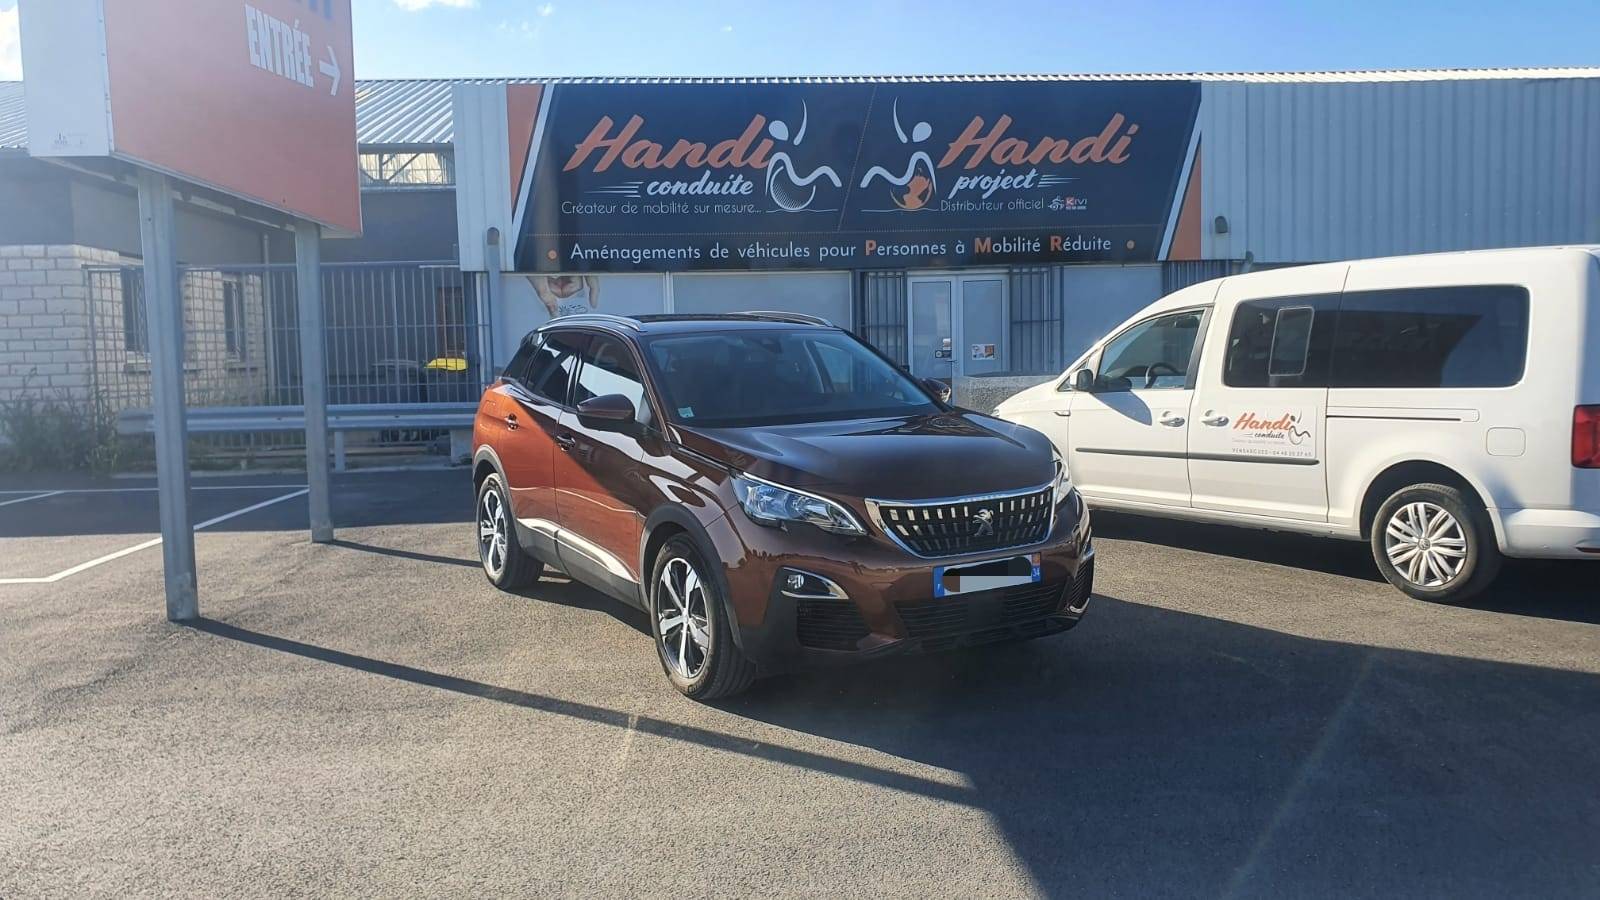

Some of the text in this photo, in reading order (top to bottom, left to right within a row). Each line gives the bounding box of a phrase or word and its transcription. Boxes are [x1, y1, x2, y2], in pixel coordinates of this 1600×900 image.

[245, 4, 314, 88] ENTRÉE
[562, 113, 775, 173] Handi
[937, 112, 1139, 170] Handi
[646, 170, 753, 196] conduite
[948, 168, 1038, 199] project
[561, 201, 616, 215] Créateur
[621, 201, 638, 214] de
[643, 200, 689, 214] mobilité
[694, 203, 710, 214] sur
[940, 198, 1044, 212] Distributeur officiel
[570, 235, 1112, 264] Aménagements de véhicules pour Personnes à Mobilité Réduite
[1233, 412, 1292, 431] Handi
[1254, 430, 1285, 439] conduite
[1032, 567, 1041, 577] 34
